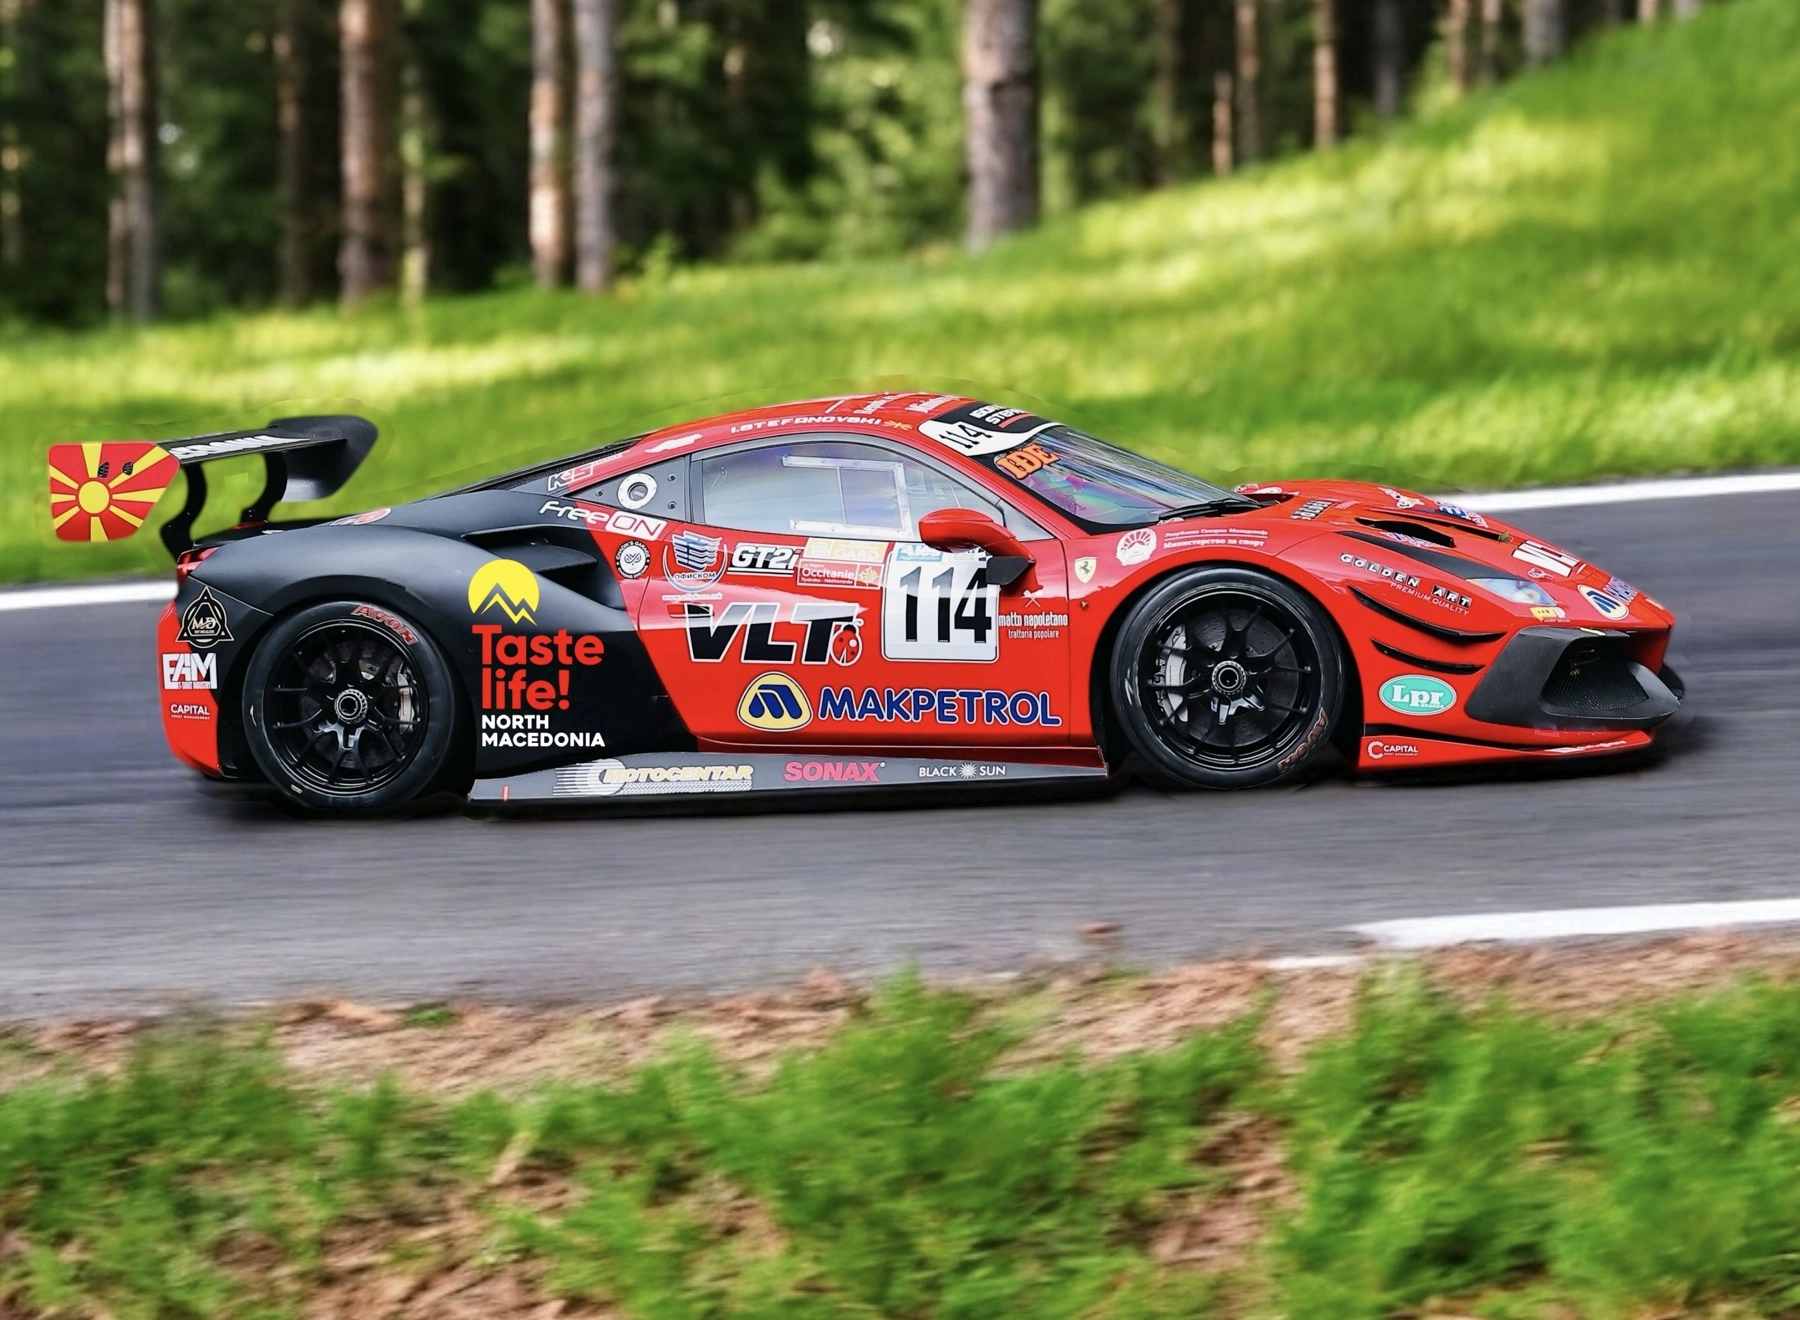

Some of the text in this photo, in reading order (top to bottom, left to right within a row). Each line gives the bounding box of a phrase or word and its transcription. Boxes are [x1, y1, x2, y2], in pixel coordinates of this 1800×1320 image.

[939, 424, 993, 449] 114
[1163, 538, 1226, 549] Министерство
[1238, 538, 1265, 547] спорт
[674, 571, 716, 579] ОФИСКОМ
[802, 567, 855, 579] Occitanie
[1340, 552, 1472, 609] GOLDEN ART
[900, 566, 992, 643] 114
[1390, 582, 1469, 616] PREMIUM QUALITY
[351, 605, 418, 645] AVON
[998, 611, 1069, 629] matto napoletano
[683, 601, 860, 665] VLT
[1008, 629, 1060, 640] trattoria popolare
[472, 624, 605, 665] Taste
[482, 667, 570, 710] life!
[1391, 684, 1445, 707] Lpr
[170, 704, 211, 716] CAPITAL
[819, 686, 1062, 726] MAKPETROL
[481, 714, 549, 729] NORTH
[481, 732, 605, 747] MACEDONIA
[1383, 744, 1419, 753] CAPITAL
[603, 765, 754, 784] MOTOCENTAR
[783, 761, 881, 782] SONAX
[918, 765, 1007, 778] BLACK SUN
